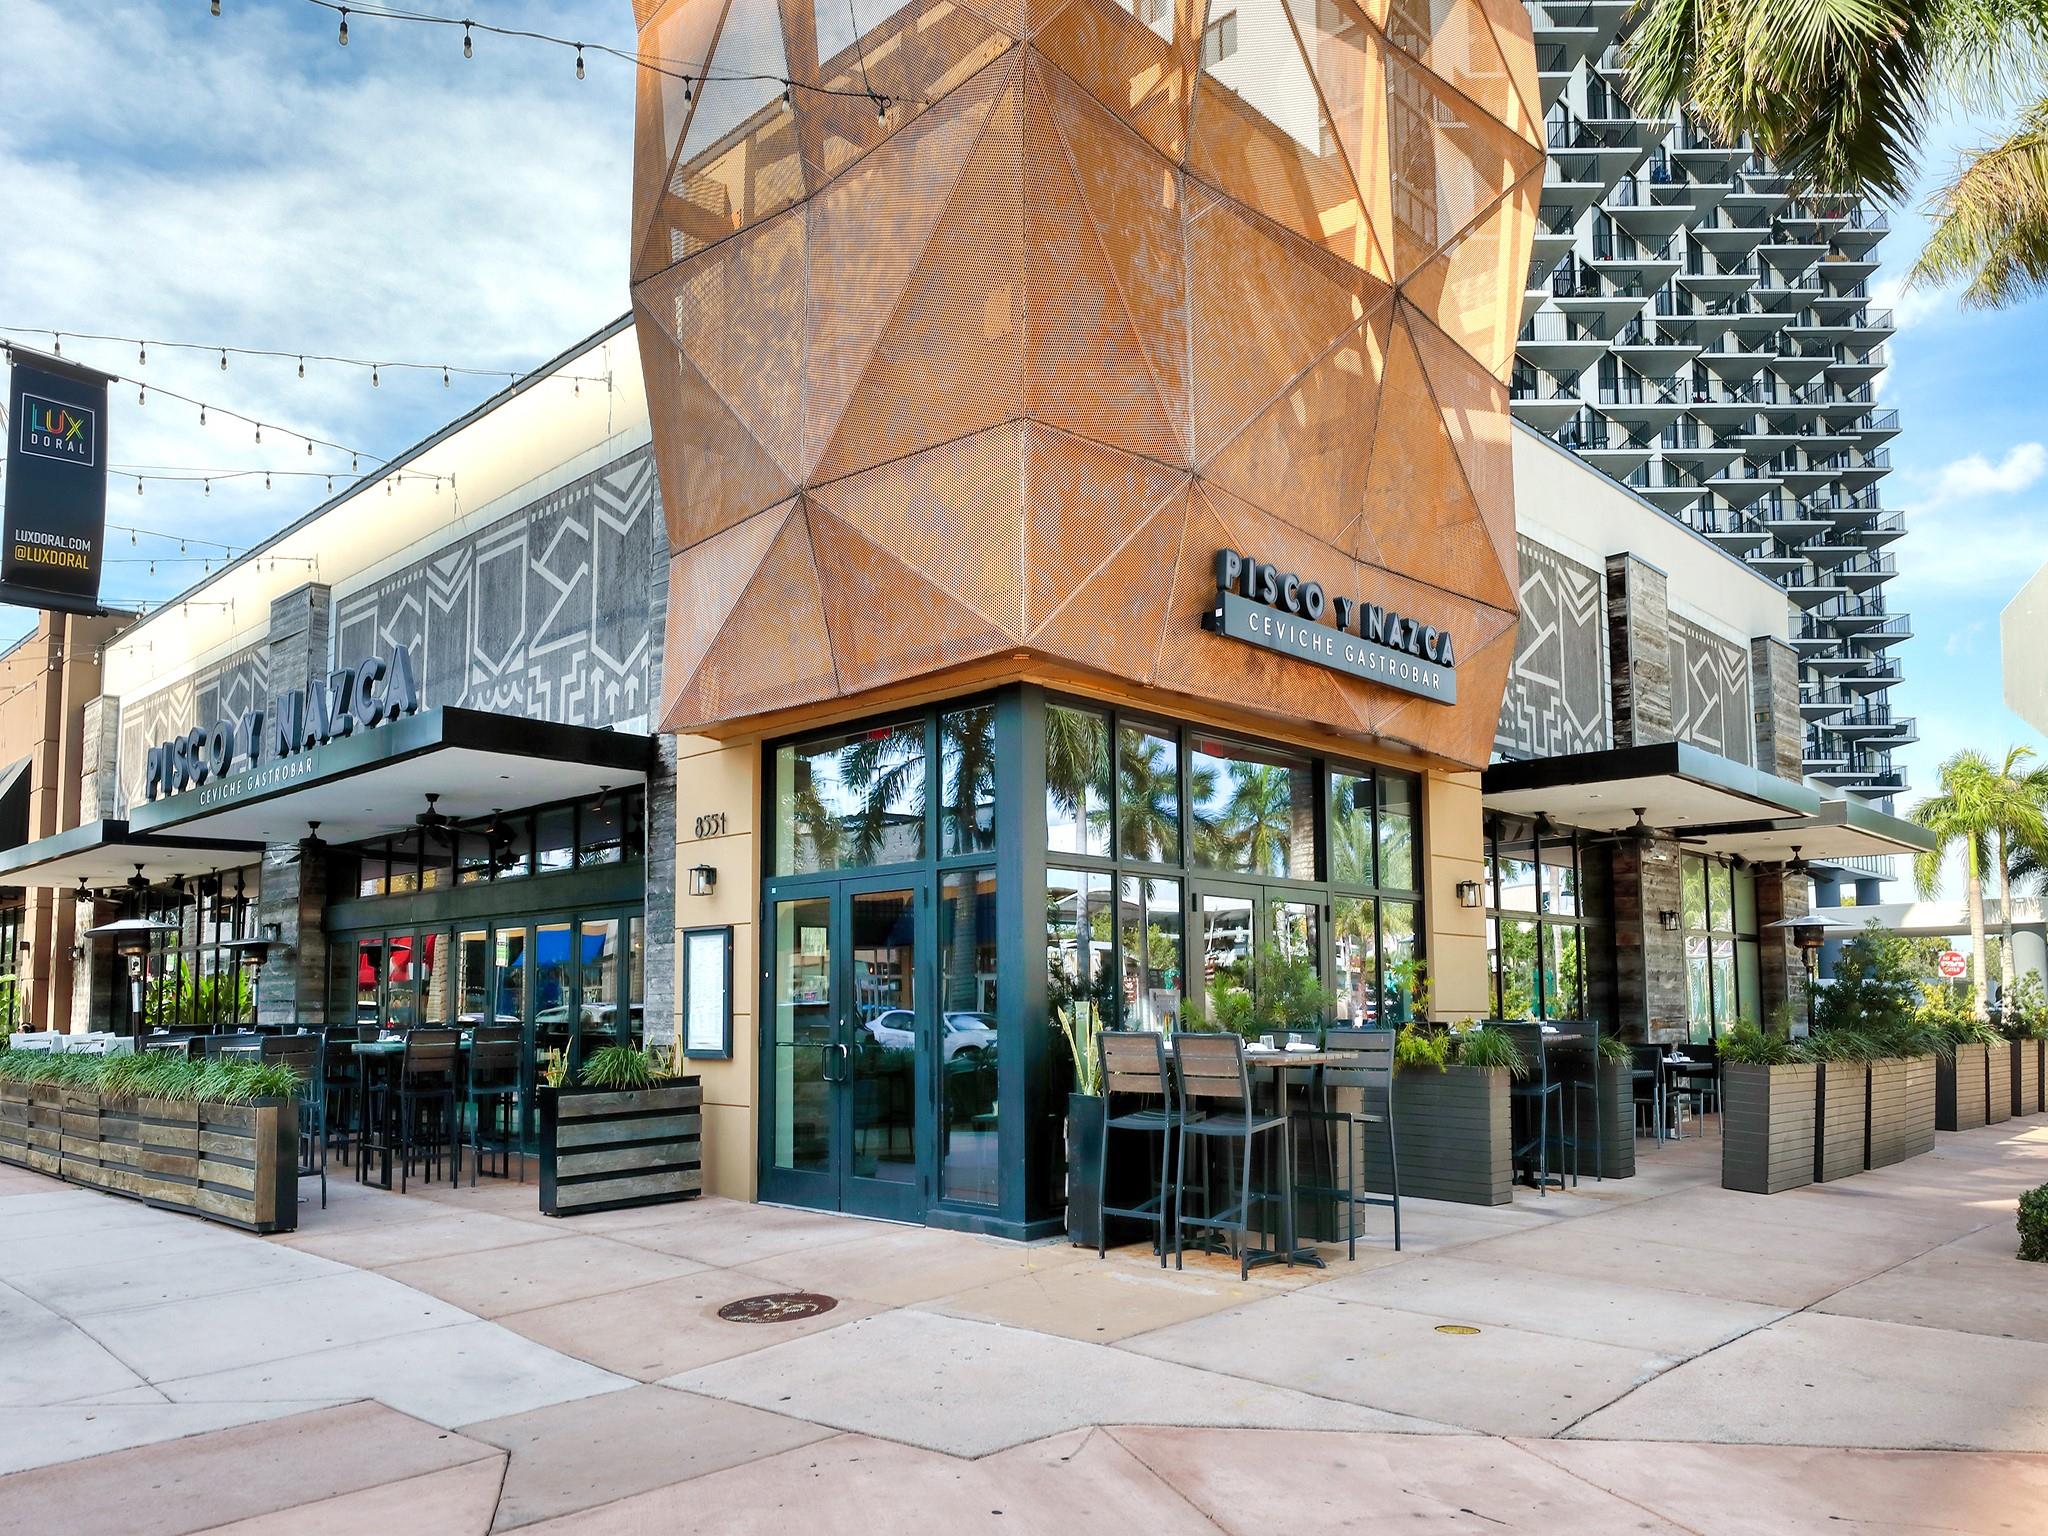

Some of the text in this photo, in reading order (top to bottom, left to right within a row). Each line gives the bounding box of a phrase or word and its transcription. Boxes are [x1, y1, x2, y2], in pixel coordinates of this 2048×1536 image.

[31, 403, 85, 442] LUX
[31, 433, 85, 455] DORAL
[14, 544, 89, 570] @LUXDORAL
[15, 528, 91, 552] LUXDORAL.COM
[1216, 548, 1455, 668] PISCO Y NAZCA
[1249, 612, 1441, 690] CEVICHE GASTROBAR
[146, 644, 417, 800] PISCO Y NAZCA
[200, 758, 312, 805] CEVICHE GASTROBAR
[695, 812, 726, 838] 8551
